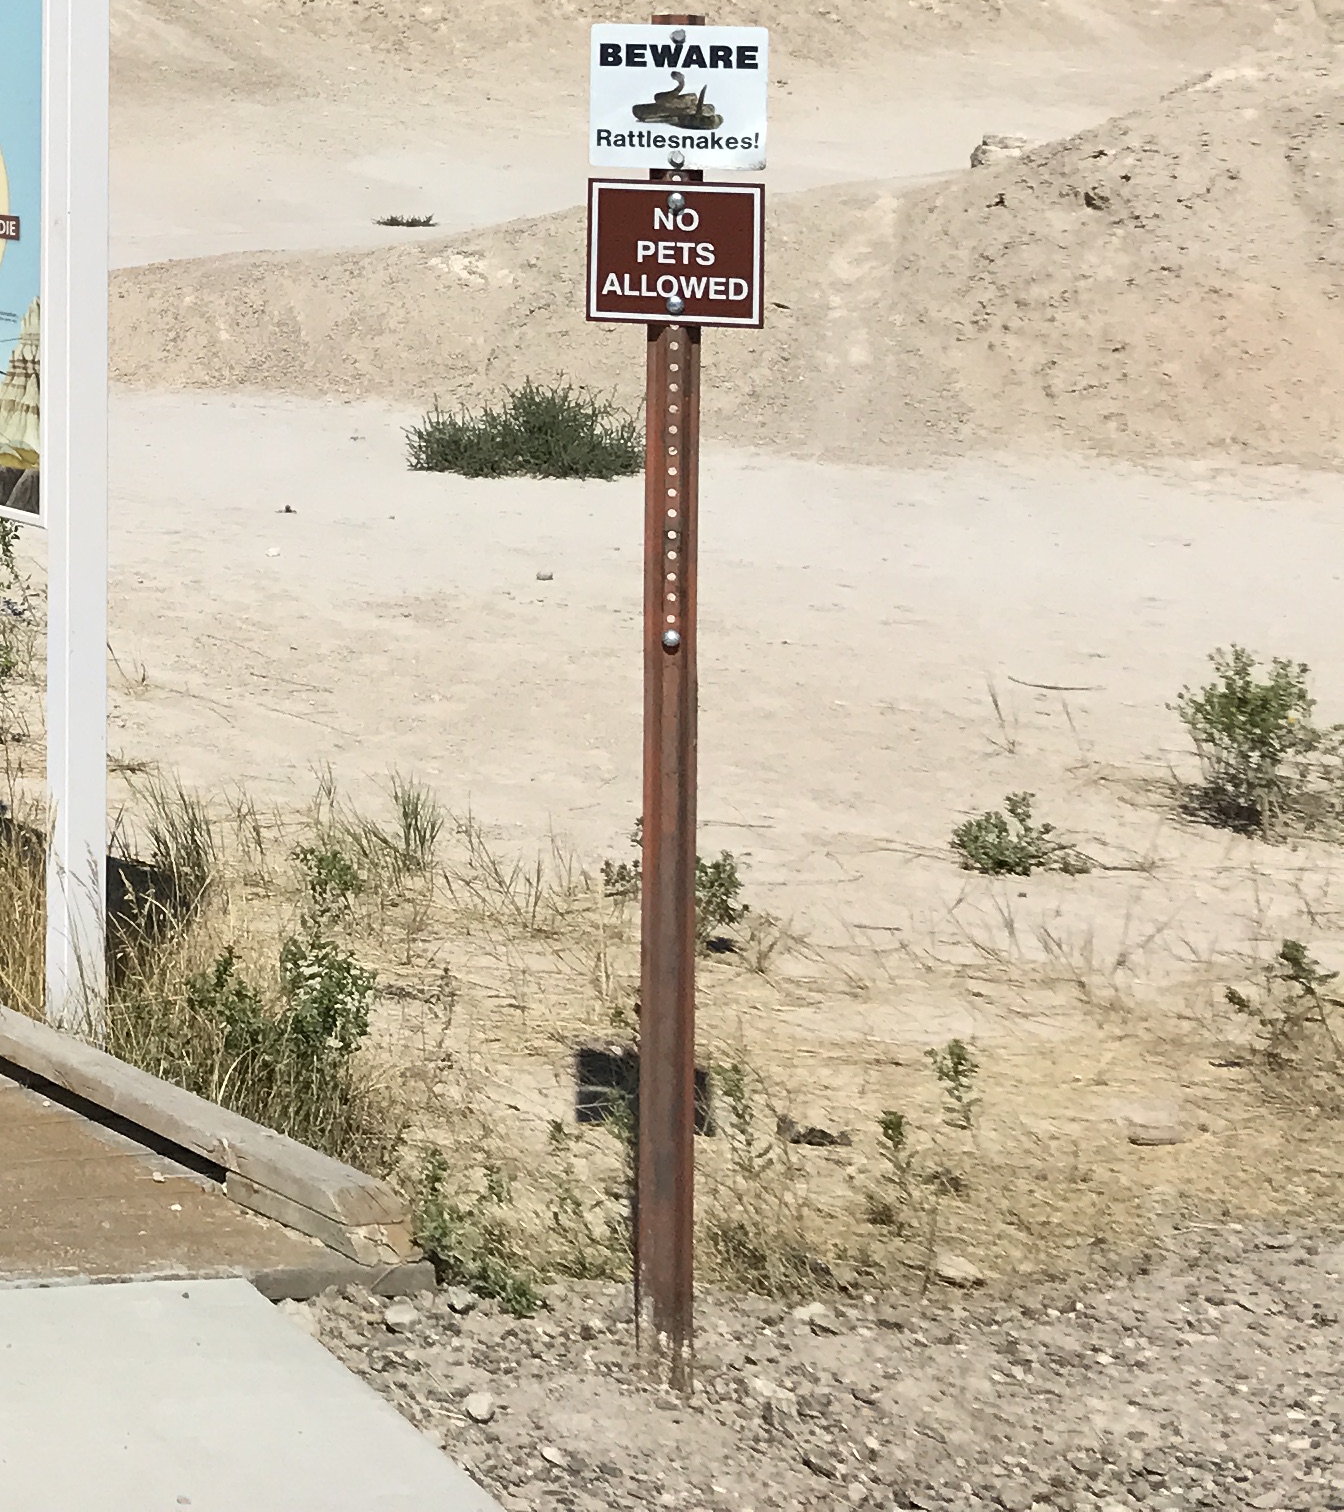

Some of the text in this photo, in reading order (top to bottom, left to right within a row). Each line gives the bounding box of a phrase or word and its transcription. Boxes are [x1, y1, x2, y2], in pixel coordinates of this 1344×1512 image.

[599, 43, 759, 70] BEWARE
[596, 128, 759, 151] Rattlesnakes!
[653, 207, 700, 232] NO
[637, 241, 716, 267] PETS
[601, 273, 749, 302] ALLOWED
